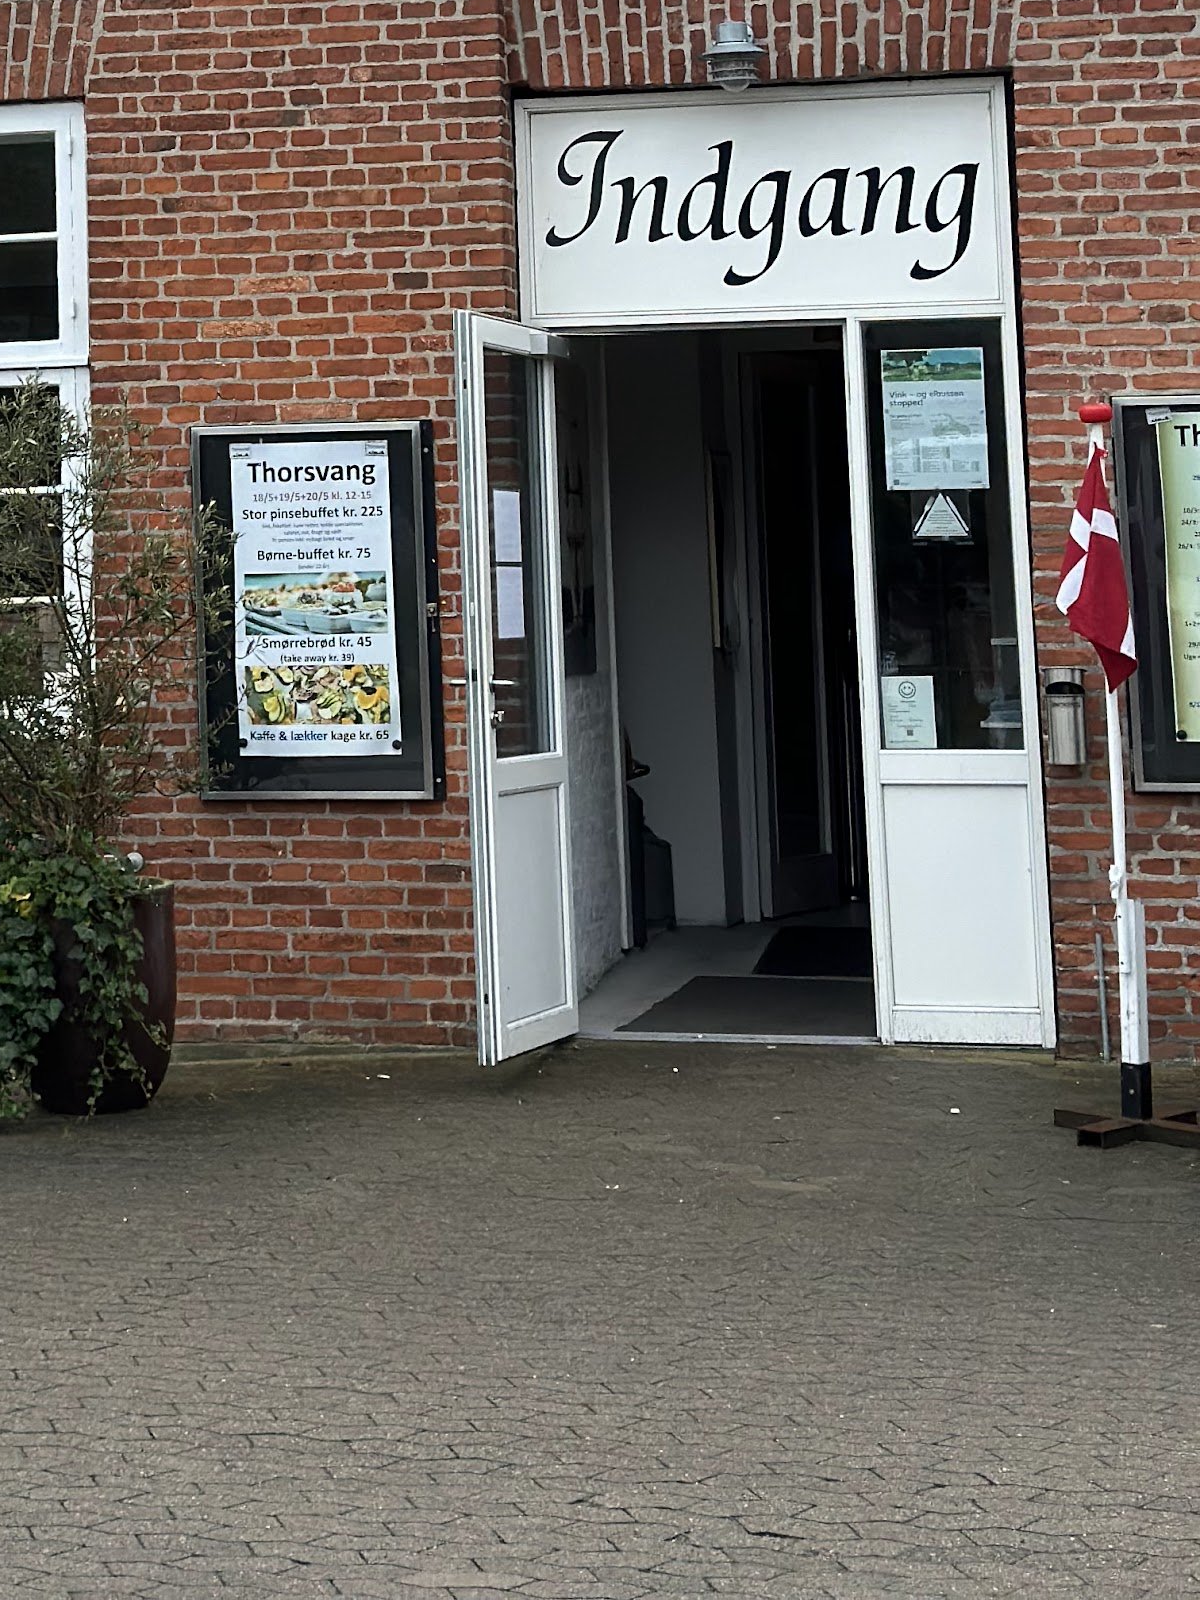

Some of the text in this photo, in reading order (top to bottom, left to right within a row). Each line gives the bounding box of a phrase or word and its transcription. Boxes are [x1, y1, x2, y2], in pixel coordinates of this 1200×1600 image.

[545, 128, 981, 286] Indgang
[247, 461, 376, 485] Thorsvang
[253, 491, 372, 503] 18/5+19/5+20/5 kl. 12-15
[242, 506, 383, 522] Stor pinsebuffet kr. 225
[257, 547, 371, 562] Børne-buffet kr. 75
[262, 636, 372, 649] Smørrebrød kr. 45
[280, 655, 301, 664] (take
[328, 654, 338, 662] kr.
[341, 653, 355, 662] 39)
[250, 730, 389, 743] Kaffe & lækker kage kr. 65
